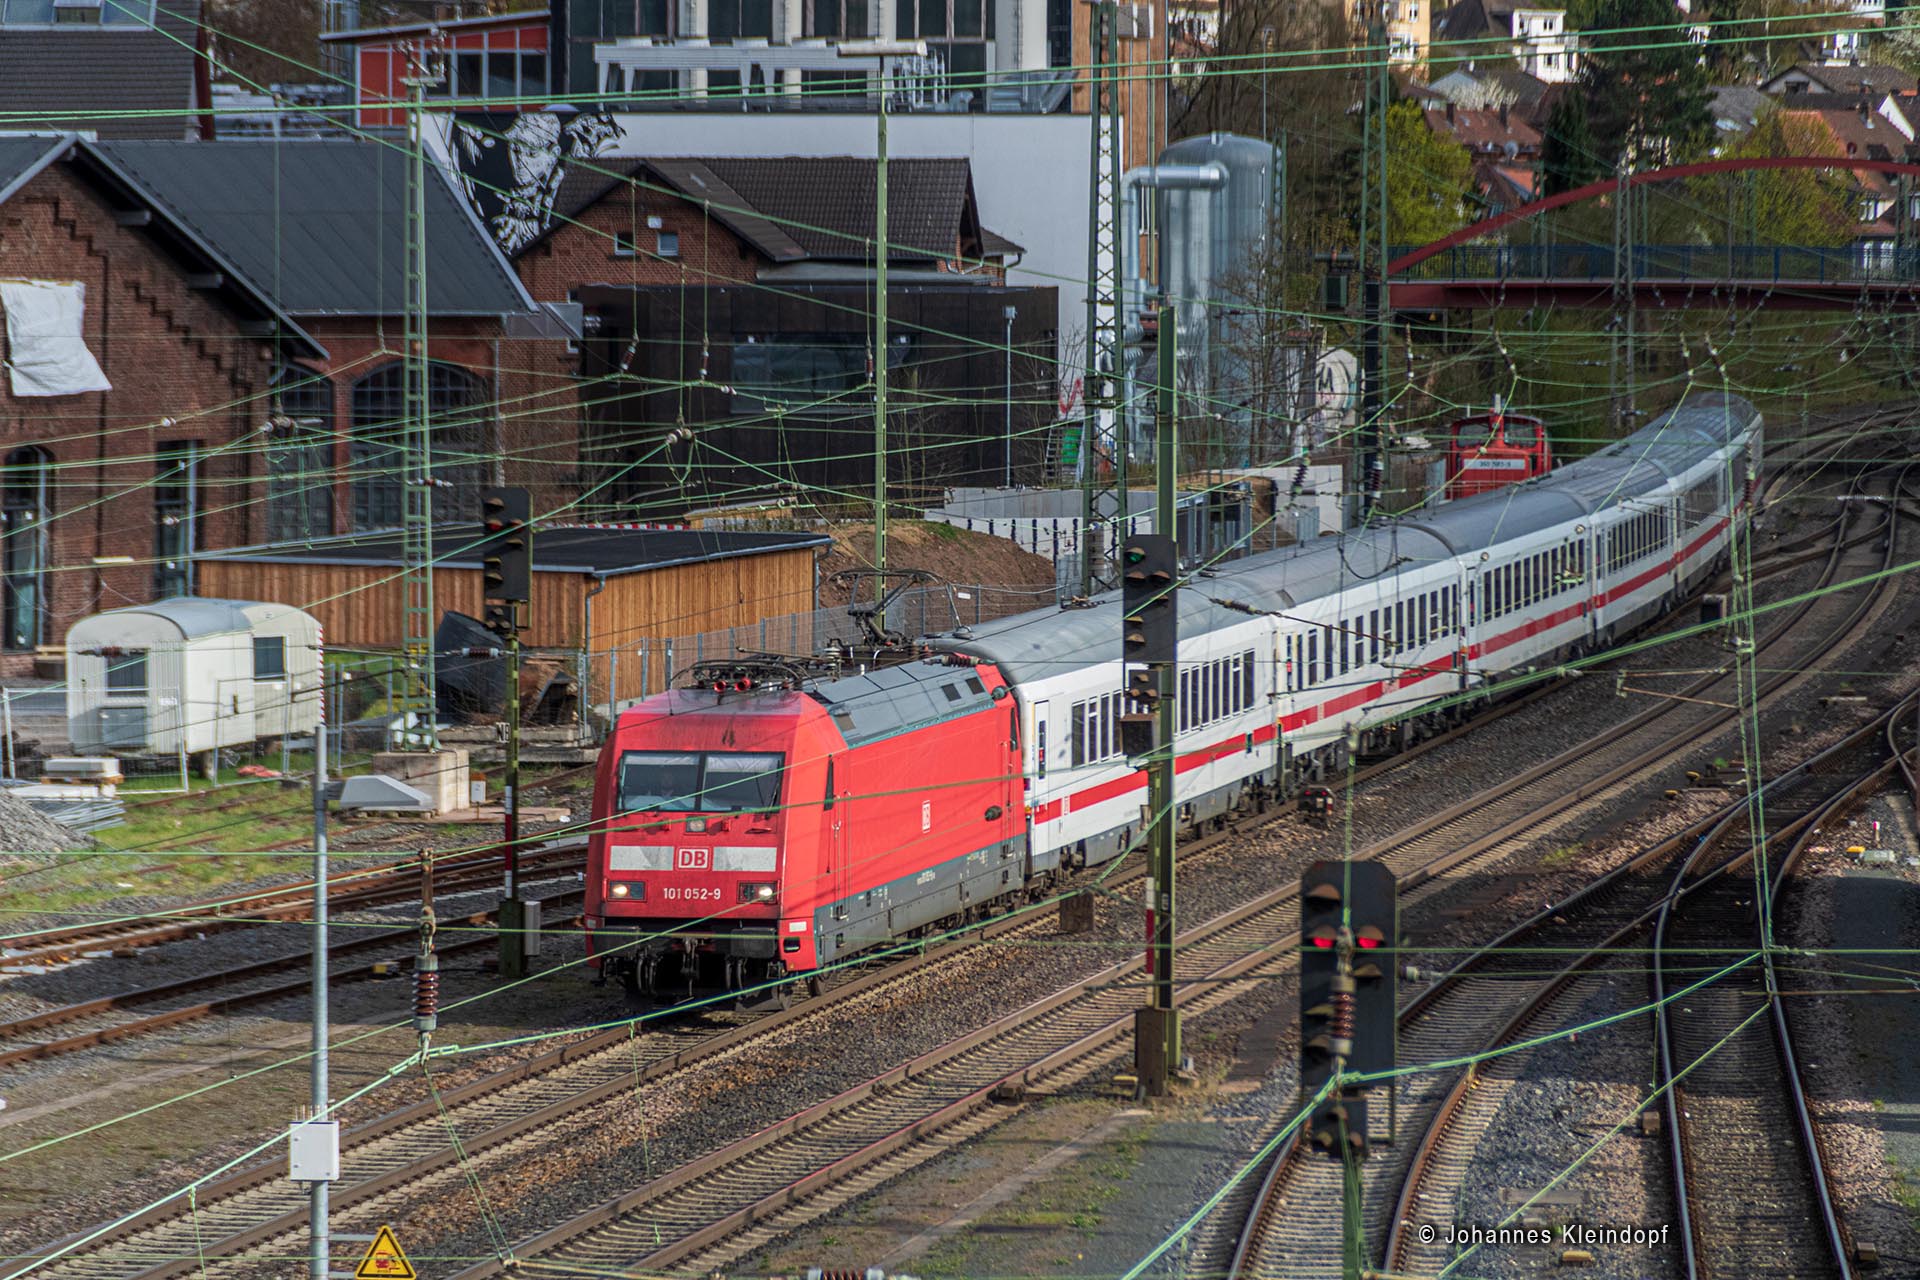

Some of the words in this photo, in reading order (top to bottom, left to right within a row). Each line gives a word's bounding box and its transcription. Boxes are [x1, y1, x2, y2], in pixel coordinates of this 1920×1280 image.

[681, 851, 706, 866] DB
[663, 887, 681, 900] 101
[684, 887, 721, 900] 052-9
